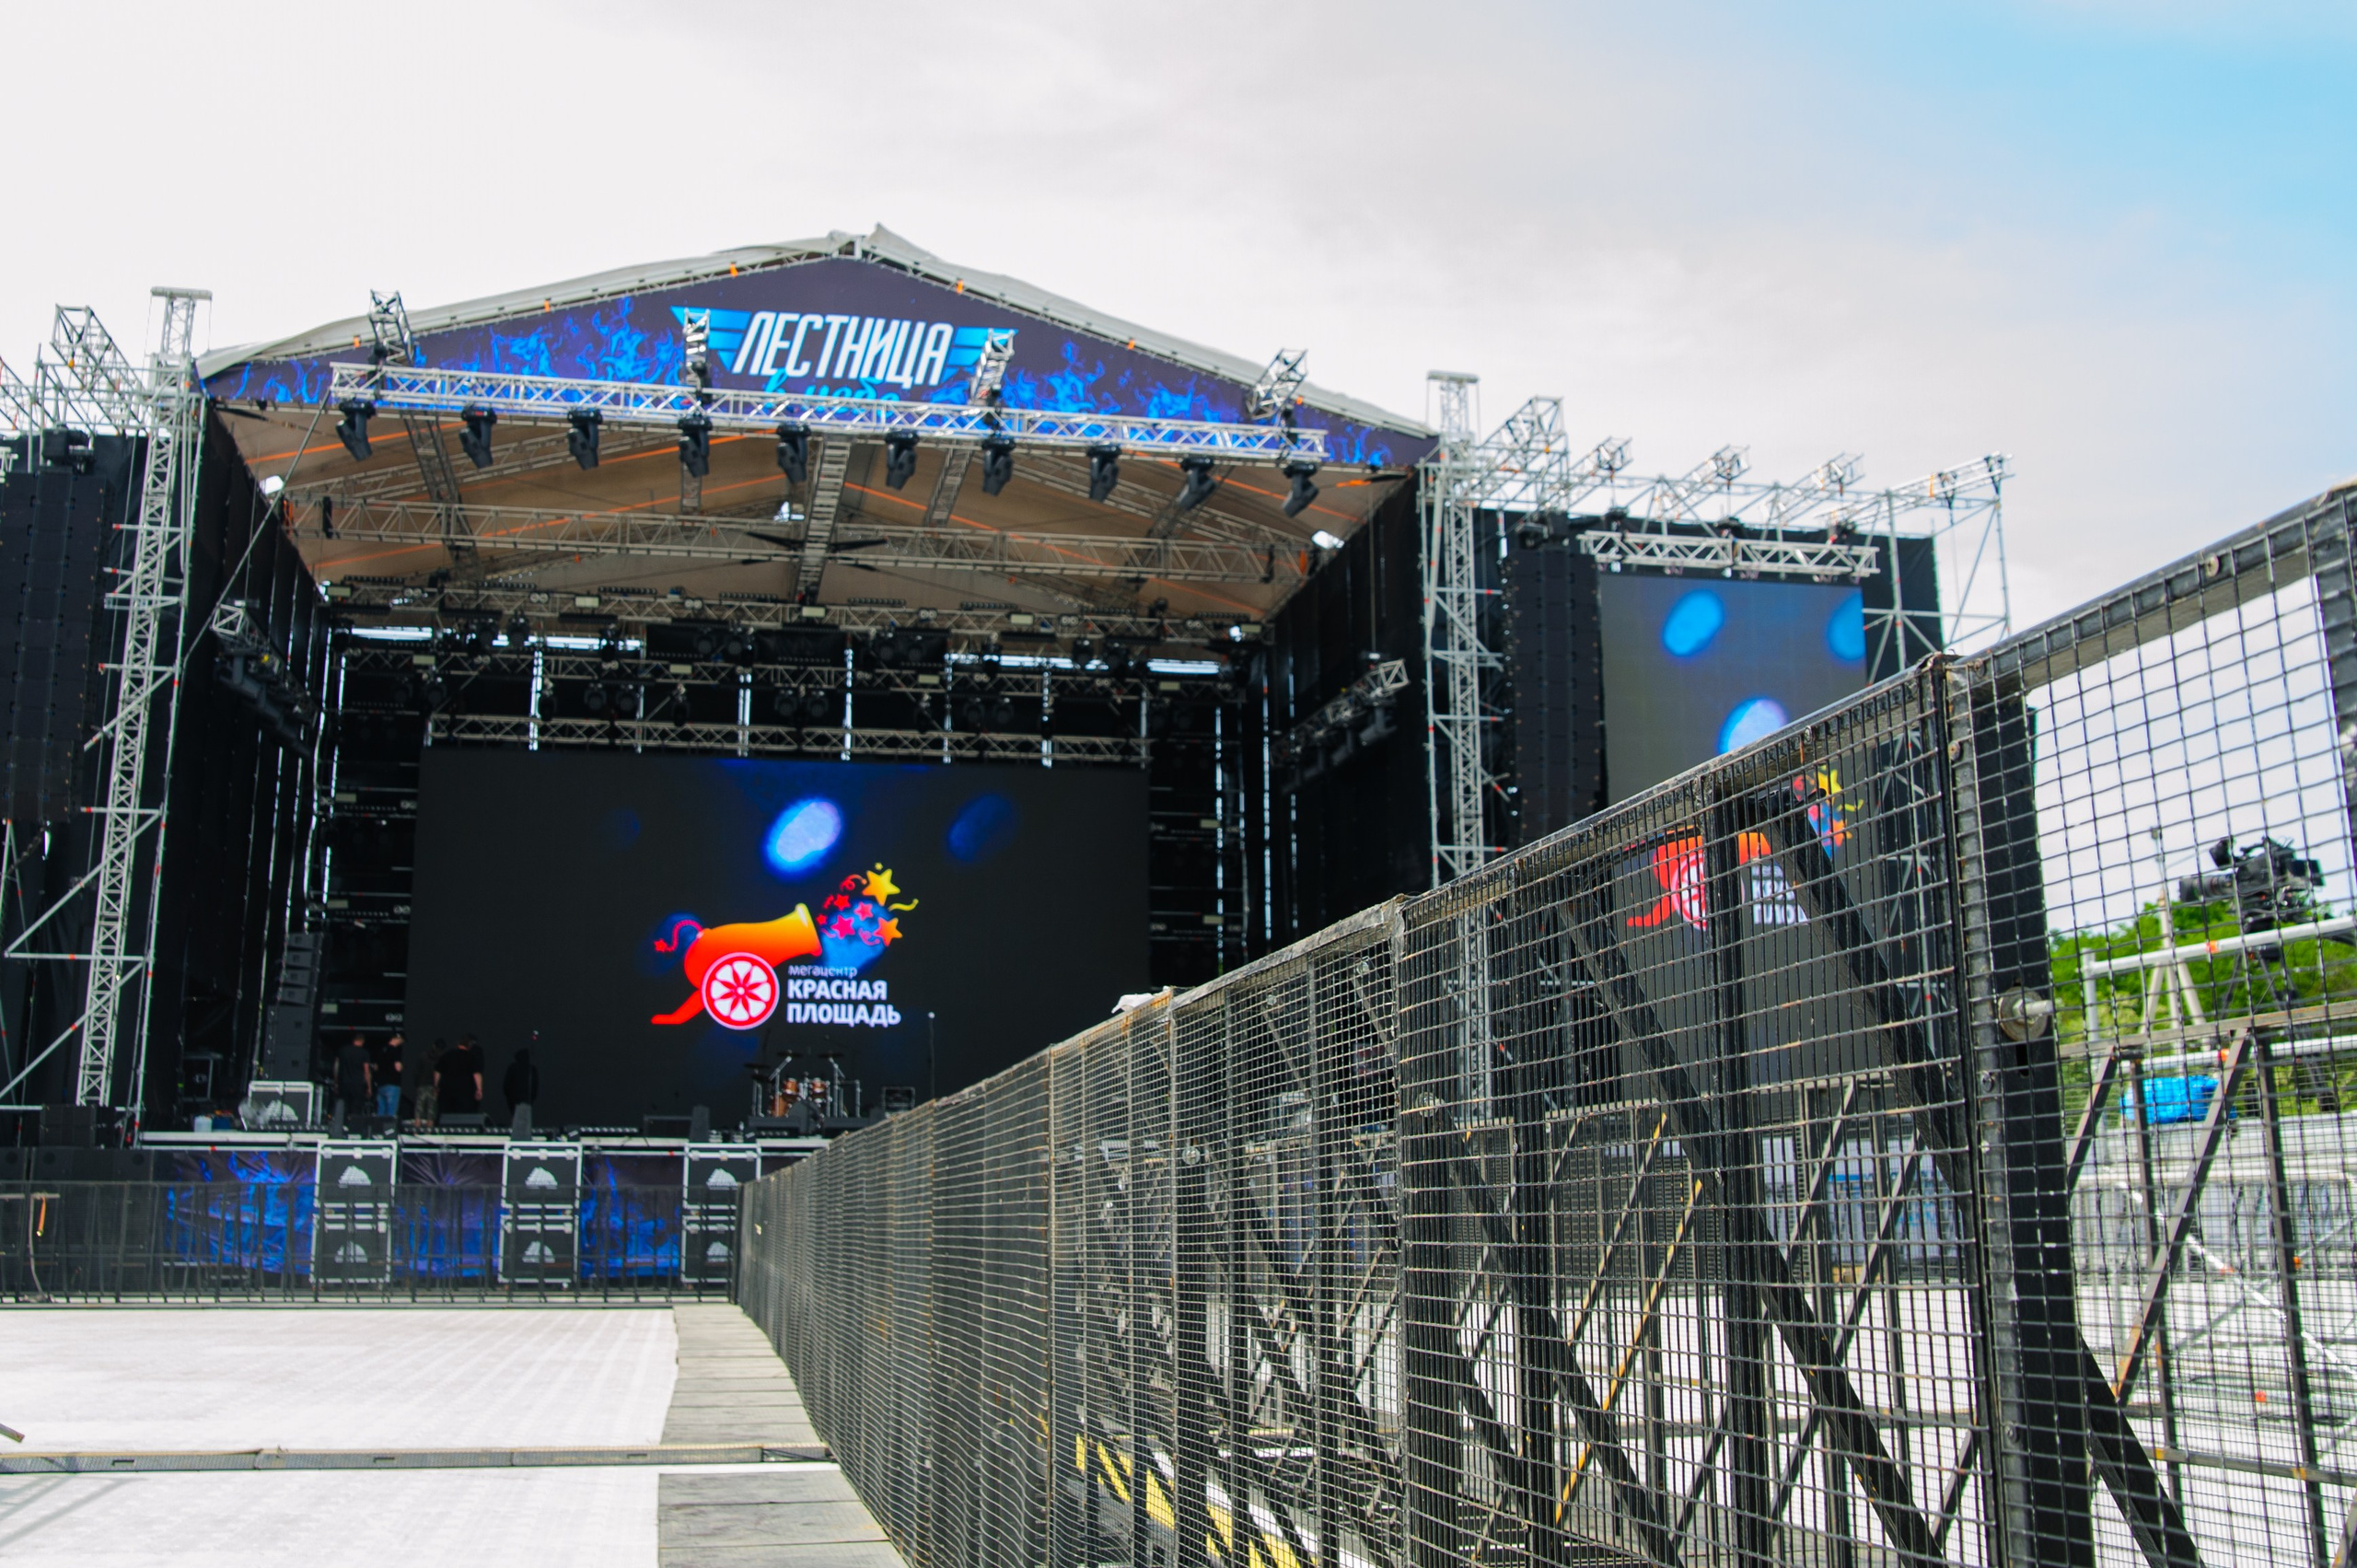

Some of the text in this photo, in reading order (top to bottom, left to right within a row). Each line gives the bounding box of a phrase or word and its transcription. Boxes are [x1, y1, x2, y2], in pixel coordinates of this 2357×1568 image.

[732, 310, 954, 390] ЛЕСТНИЦА
[789, 965, 857, 978] мегацентр
[787, 979, 888, 1000] КРАСНАЯ
[787, 1003, 901, 1028] ПЛОЩАДЬ
